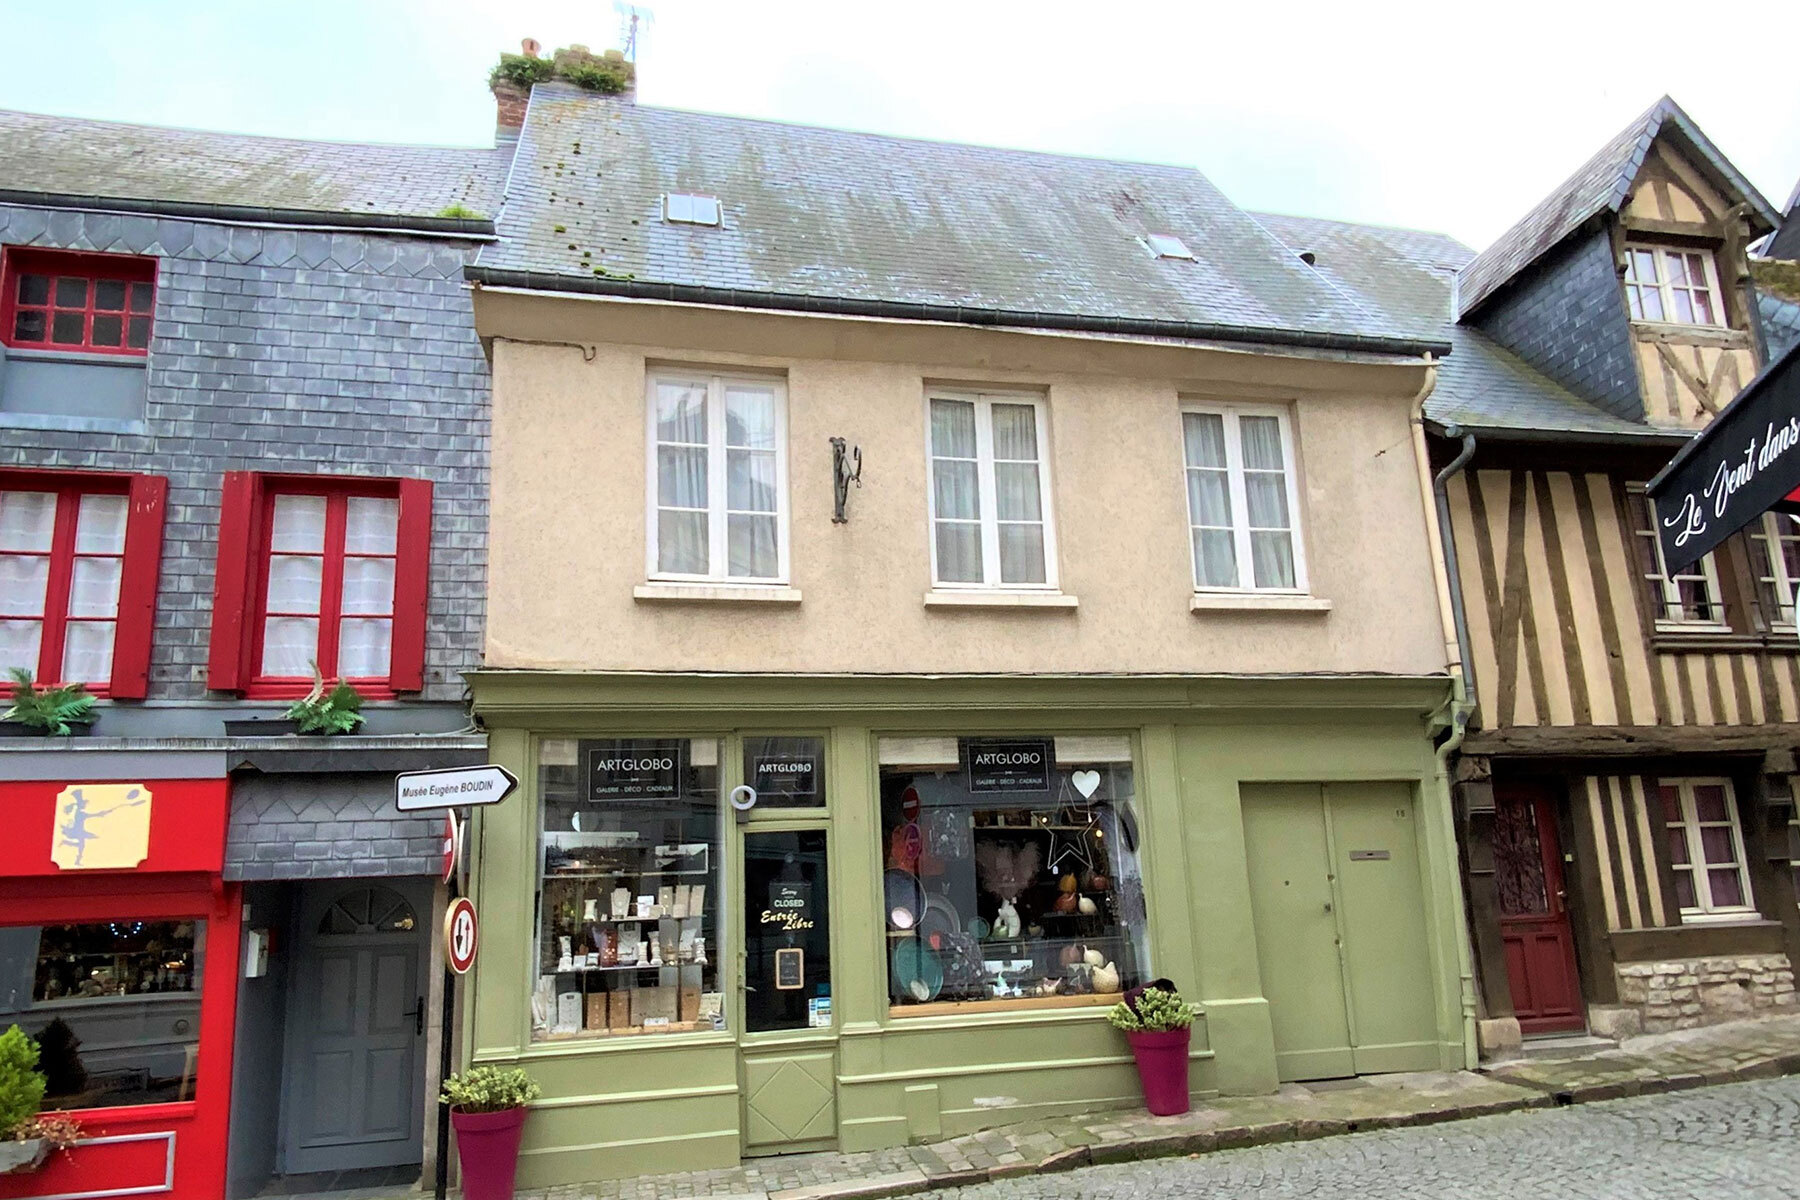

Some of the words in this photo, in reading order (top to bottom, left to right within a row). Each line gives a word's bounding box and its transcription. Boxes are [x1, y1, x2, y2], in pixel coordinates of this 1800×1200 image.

[1664, 494, 1706, 547] Le
[1703, 438, 1756, 518] Vent
[1758, 417, 1799, 471] dans
[597, 758, 673, 771] ARTGLOBO
[975, 752, 1041, 765] ARTGLOBO
[402, 787, 428, 798] Musée
[429, 785, 459, 797] Eugène
[460, 780, 494, 792] BOUDIN
[774, 899, 805, 908] CLOSED
[760, 909, 799, 923] Entrée
[782, 917, 814, 930] Libre
